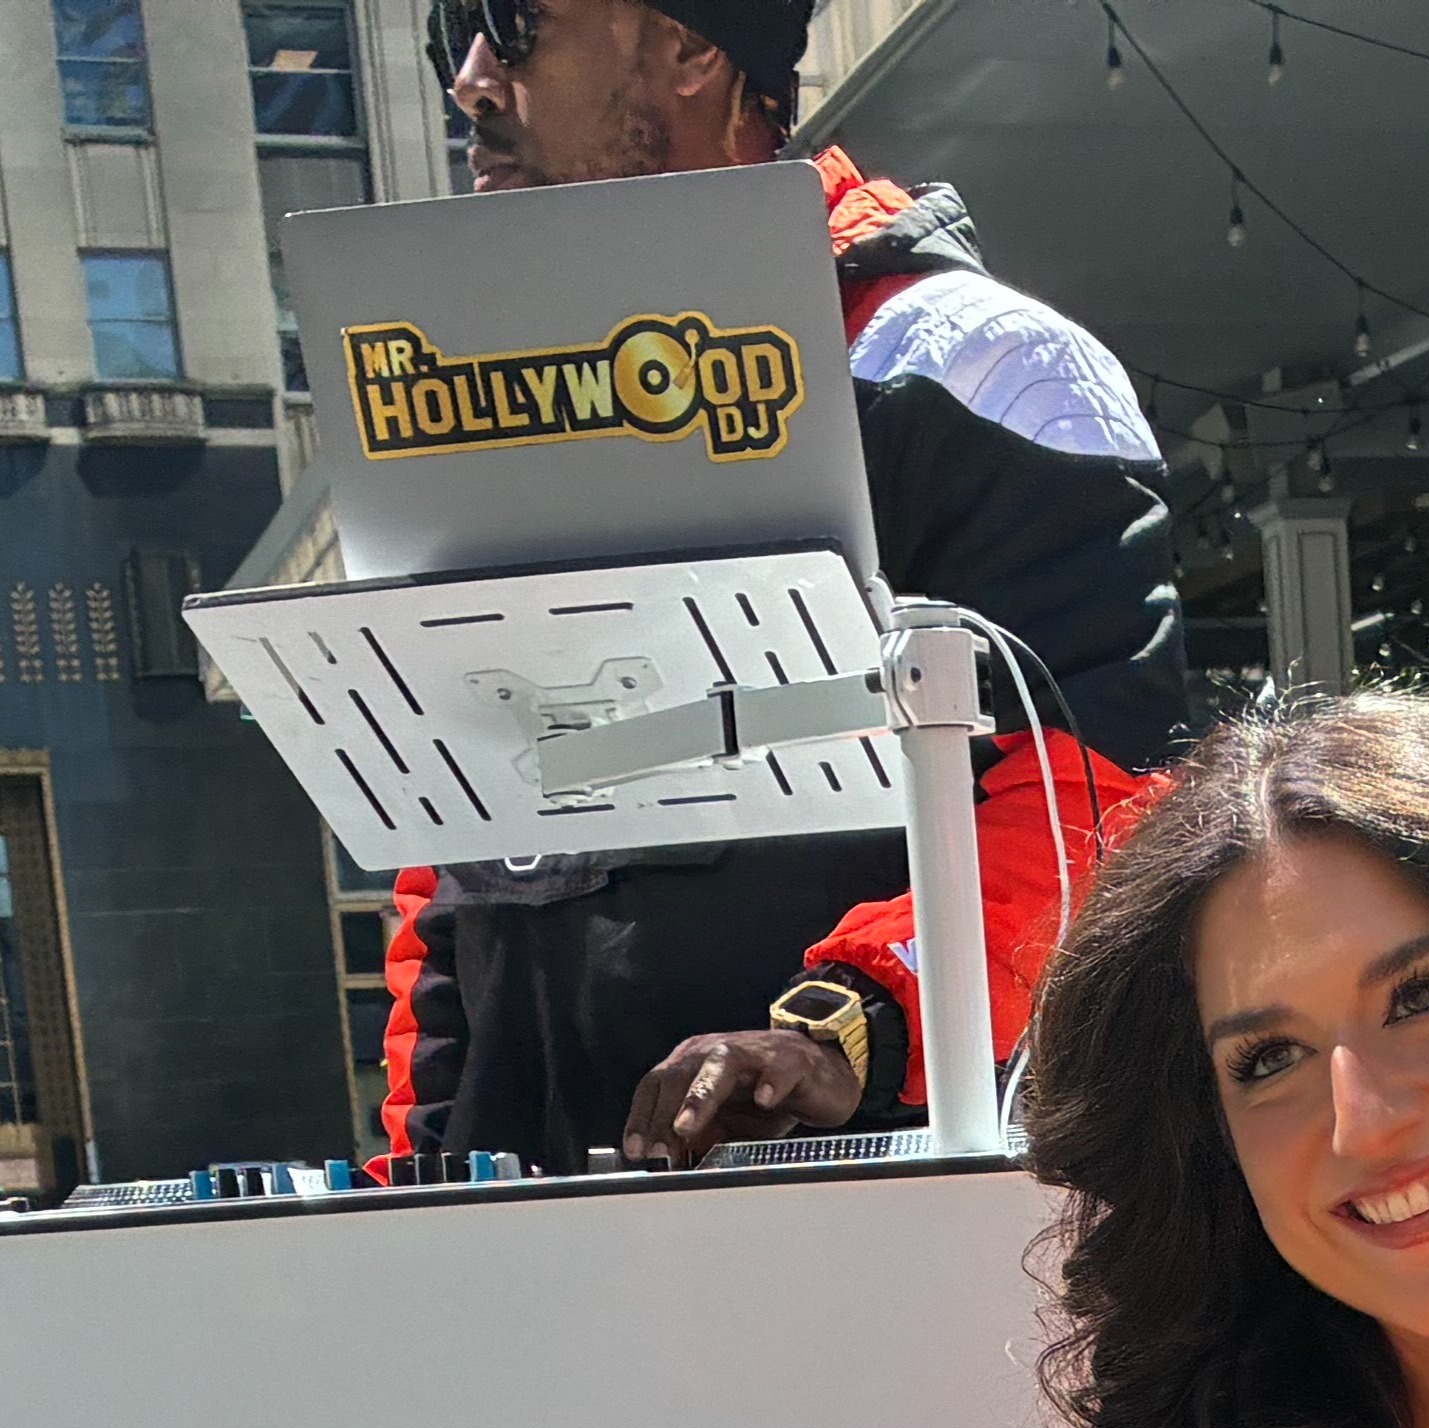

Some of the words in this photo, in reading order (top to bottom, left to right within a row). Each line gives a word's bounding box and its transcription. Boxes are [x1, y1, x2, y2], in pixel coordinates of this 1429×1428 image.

[360, 340, 430, 380] MR.
[364, 330, 788, 441] HOLLYWOOD
[718, 402, 770, 443] DJ
